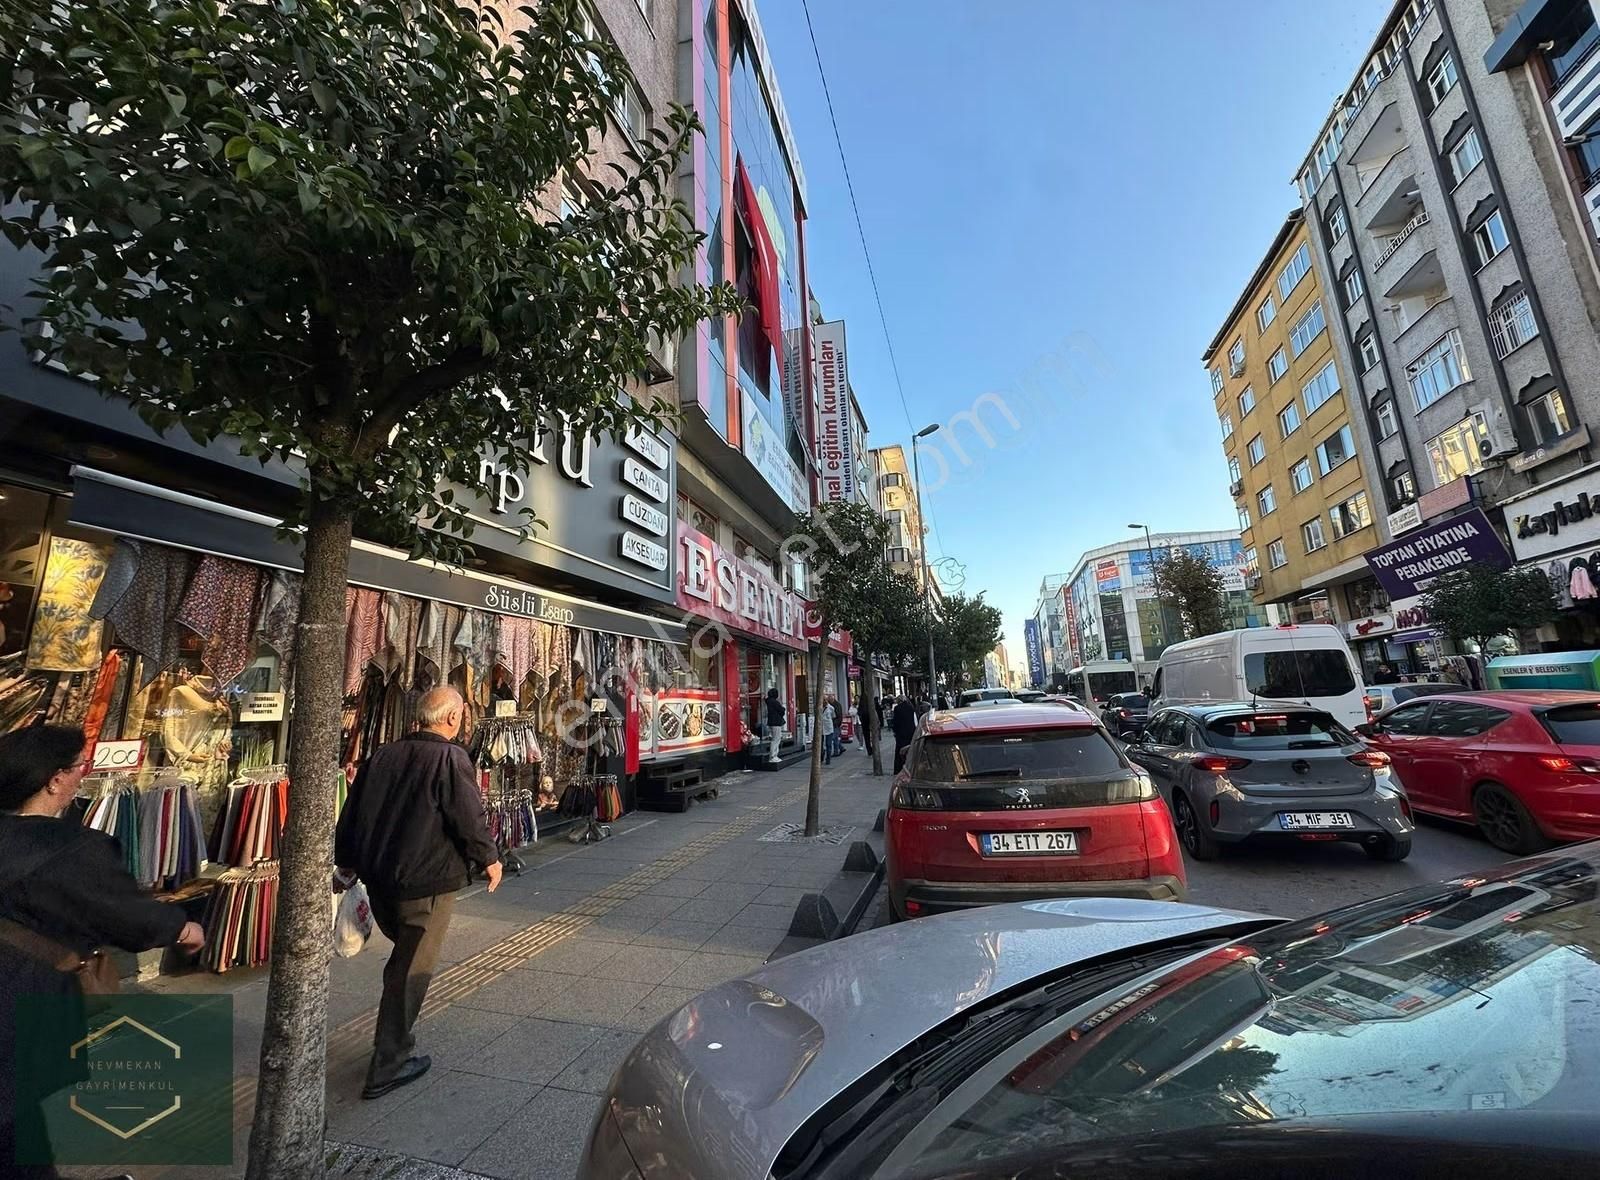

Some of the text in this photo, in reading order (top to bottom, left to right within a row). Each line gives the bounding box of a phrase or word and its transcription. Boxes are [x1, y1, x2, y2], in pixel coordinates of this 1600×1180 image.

[818, 339, 837, 415] kurumları
[839, 384, 849, 427] olanların
[639, 437, 657, 459] ŞAL
[821, 419, 843, 471] eğitim
[842, 425, 851, 459] başarı
[633, 467, 662, 495] ÇANTA
[628, 501, 666, 532] CÜZDAN
[624, 534, 666, 565] AKSESUAR
[1371, 521, 1480, 569] TOPTAN FİYATINA
[1394, 546, 1473, 581] PERAKENDE
[485, 584, 574, 624] Süslü Eşarp
[1502, 667, 1528, 675] ESENLER
[94, 746, 139, 768] 200
[1286, 814, 1301, 825] 34
[1329, 813, 1351, 825] 351
[992, 835, 1010, 851] 34
[1015, 834, 1040, 850] ETT
[1046, 833, 1073, 850] 267
